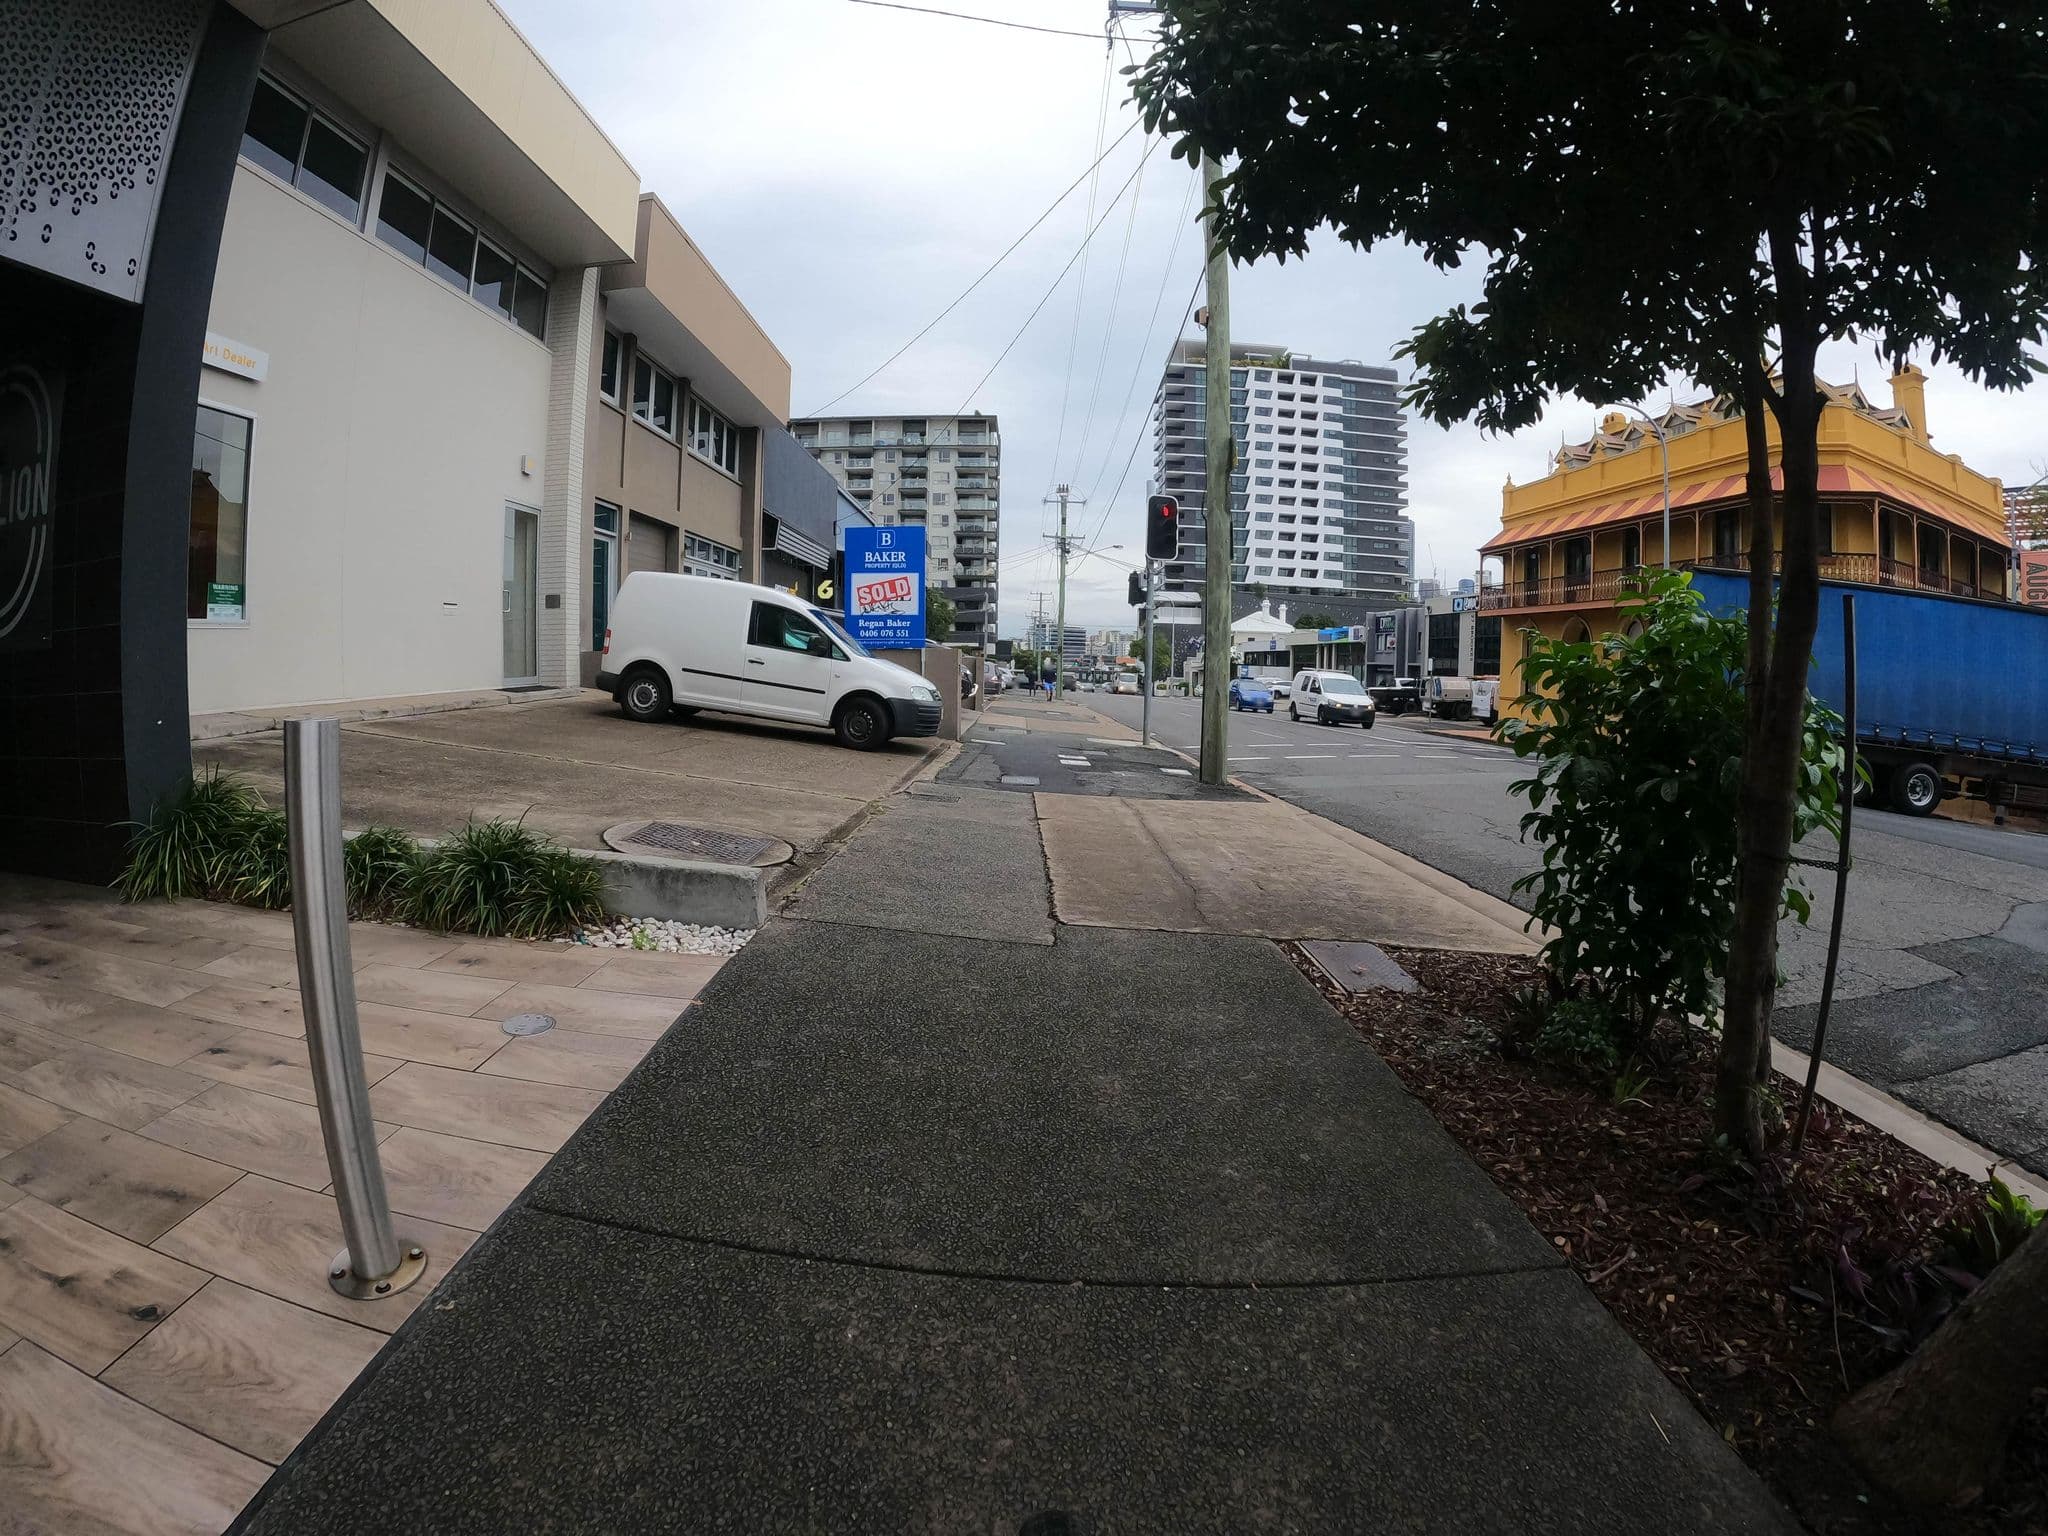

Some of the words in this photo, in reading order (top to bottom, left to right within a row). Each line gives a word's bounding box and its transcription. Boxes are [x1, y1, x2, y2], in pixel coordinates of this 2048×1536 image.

[223, 347, 256, 368] Dealer
[881, 533, 892, 546] B
[864, 551, 906, 562] BAKER
[817, 579, 834, 600] 6
[859, 579, 909, 604] SOLD
[858, 619, 884, 629] Regan
[886, 619, 911, 627] Baker
[860, 629, 879, 637] 0406
[880, 629, 894, 637] 076
[895, 629, 909, 637] 551
